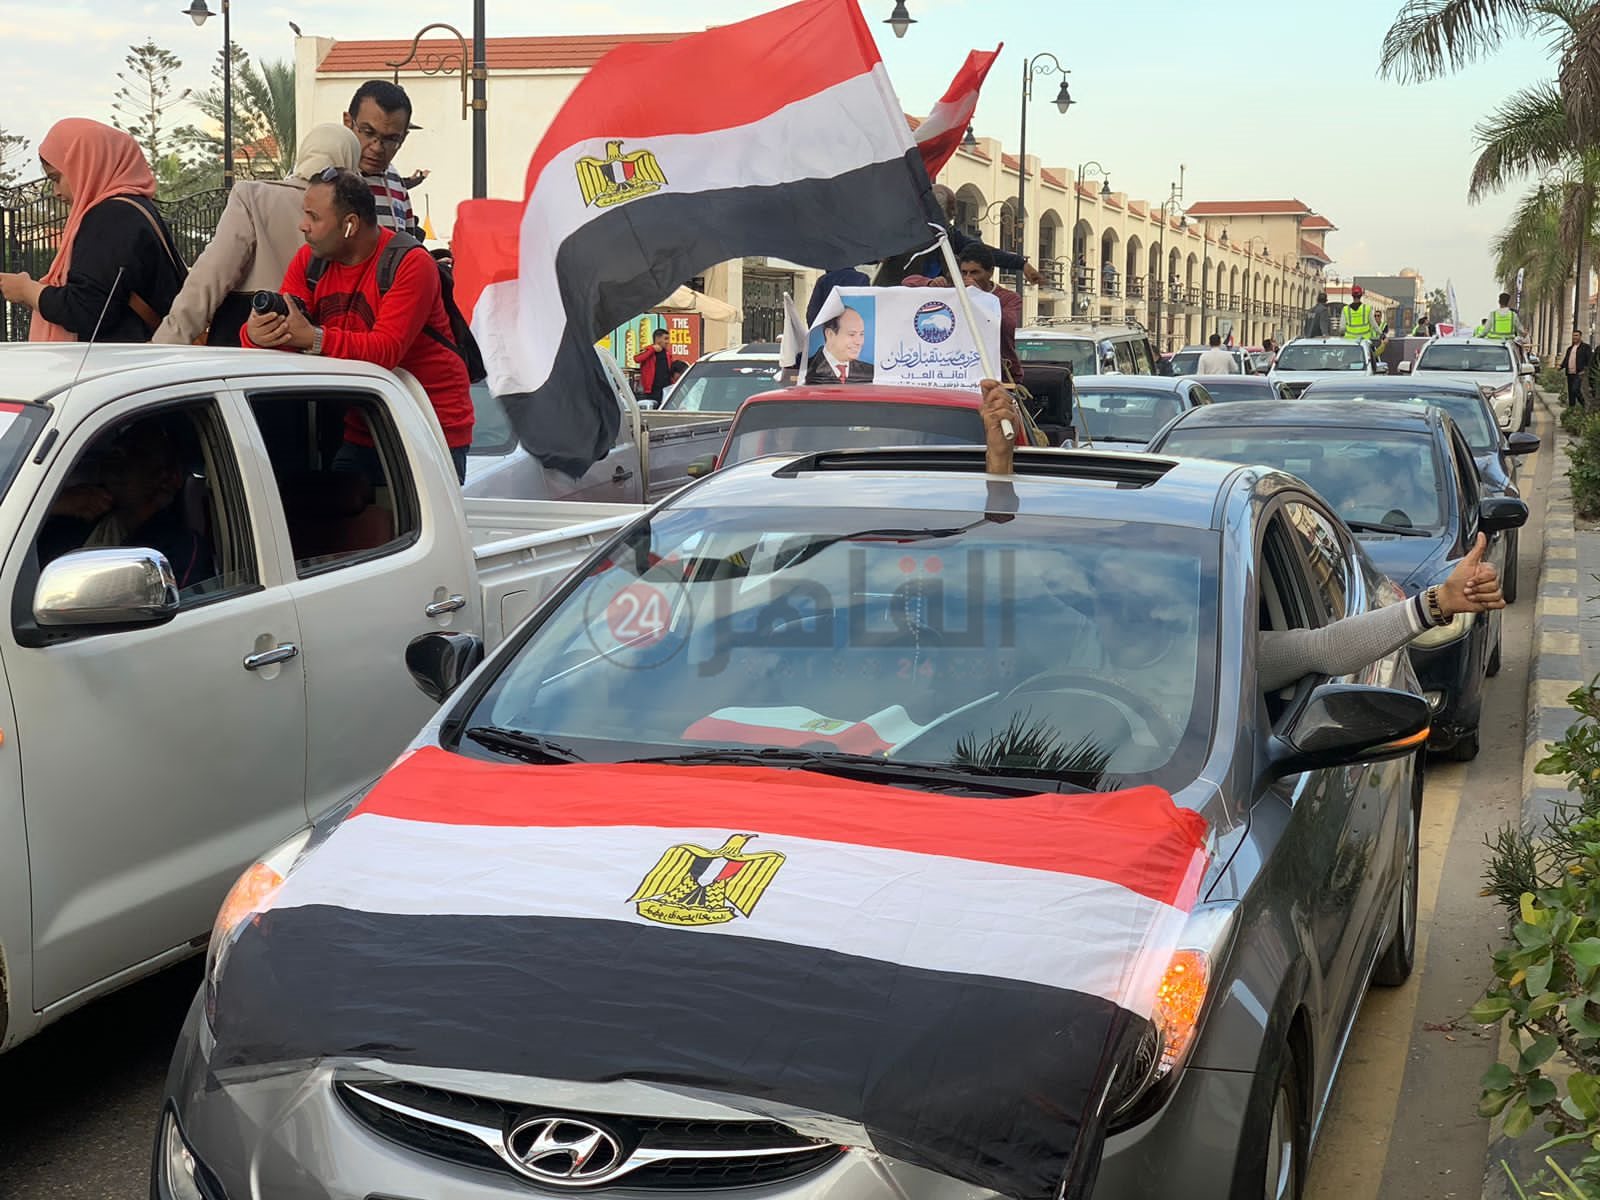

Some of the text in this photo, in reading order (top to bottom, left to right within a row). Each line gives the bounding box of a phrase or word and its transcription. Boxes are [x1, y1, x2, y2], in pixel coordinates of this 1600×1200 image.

[672, 318, 689, 329] THE
[669, 328, 692, 345] BIG
[671, 344, 689, 356] DOG
